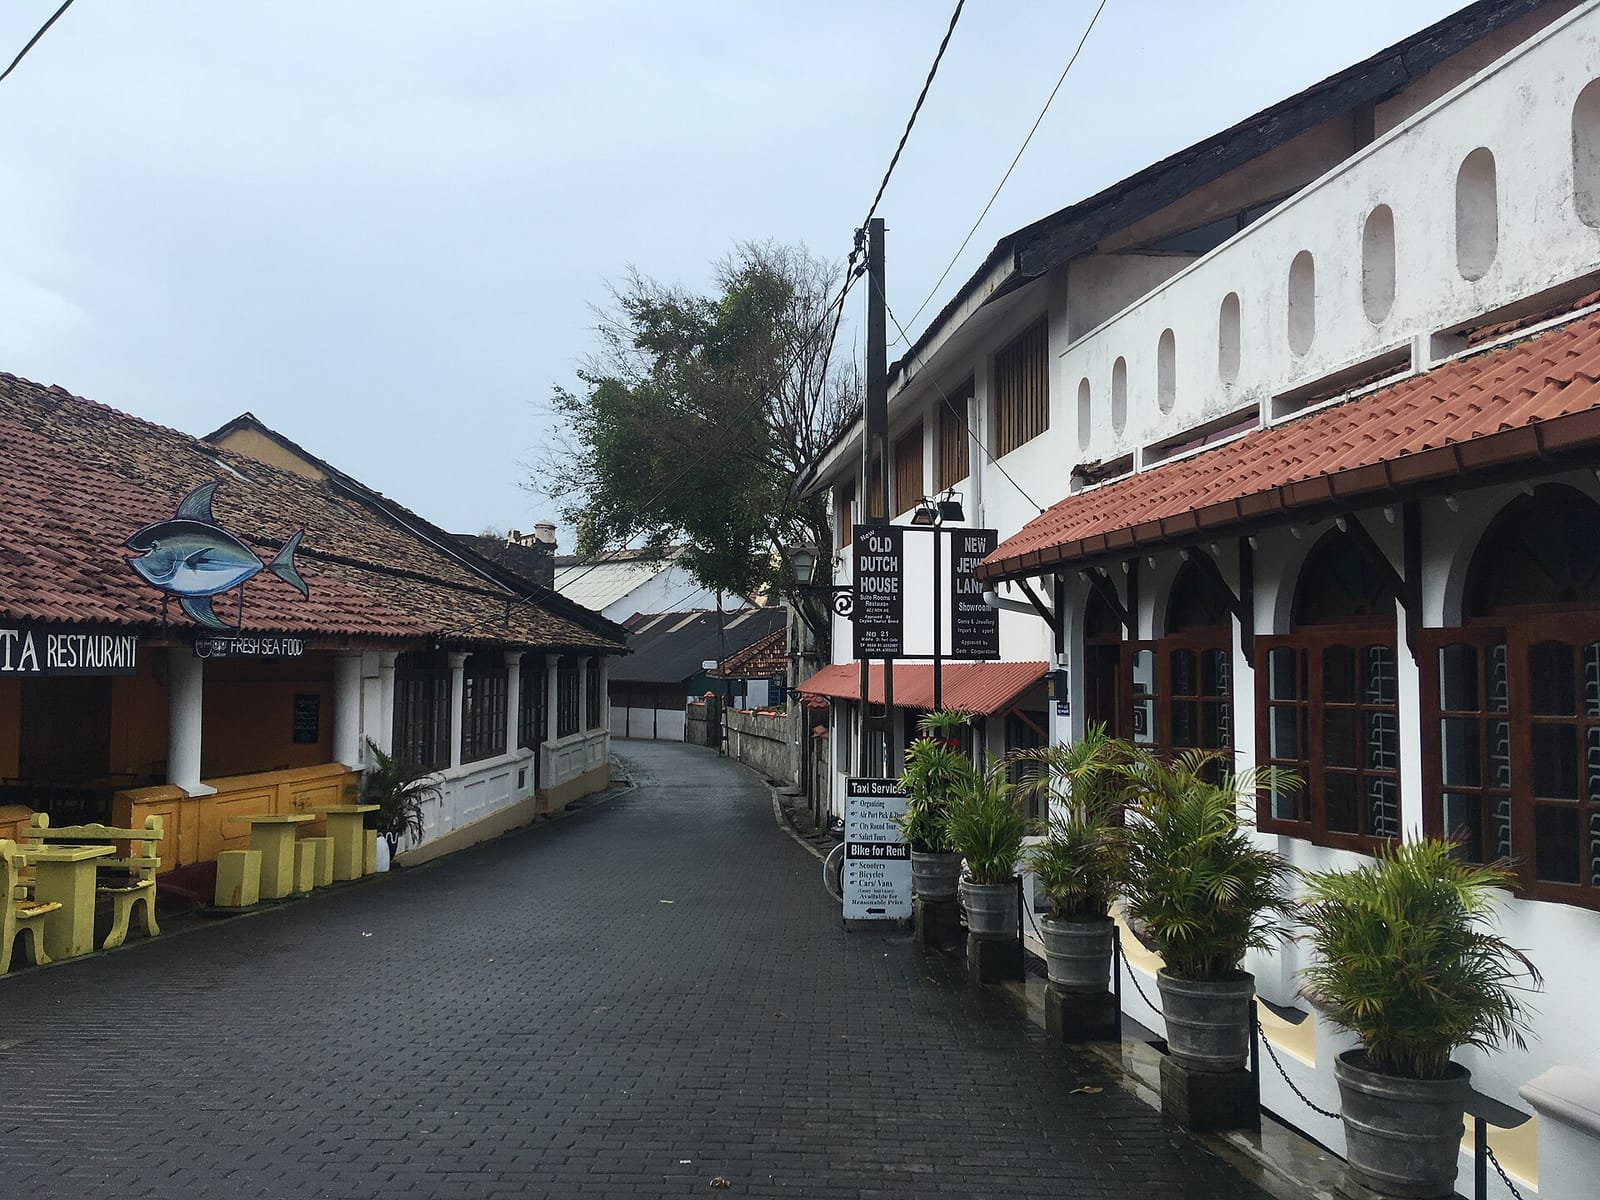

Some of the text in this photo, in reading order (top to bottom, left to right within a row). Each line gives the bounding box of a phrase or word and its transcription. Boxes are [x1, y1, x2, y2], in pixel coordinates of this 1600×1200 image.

[860, 530, 875, 541] New
[869, 536, 892, 553] OLD
[964, 537, 986, 553] NEW
[860, 556, 898, 572] DUTCH
[860, 577, 898, 593] HOUSE
[958, 602, 992, 612] Showroom
[880, 630, 889, 638] 21
[47, 634, 138, 668] RESTAURANT
[230, 638, 304, 656] FRESH SEA FOOD
[851, 782, 870, 794] Taxi
[860, 800, 885, 809] Organizing
[860, 811, 868, 819] Air
[868, 811, 878, 819] Port
[878, 811, 888, 819] Pick
[859, 822, 869, 832] City
[869, 822, 886, 831] Round
[858, 833, 887, 841] Safari Tours
[851, 844, 906, 857] Bike for Rent
[859, 861, 886, 870] Scooters
[858, 870, 885, 880] Bicycles
[858, 879, 893, 888] Cars/ Vans
